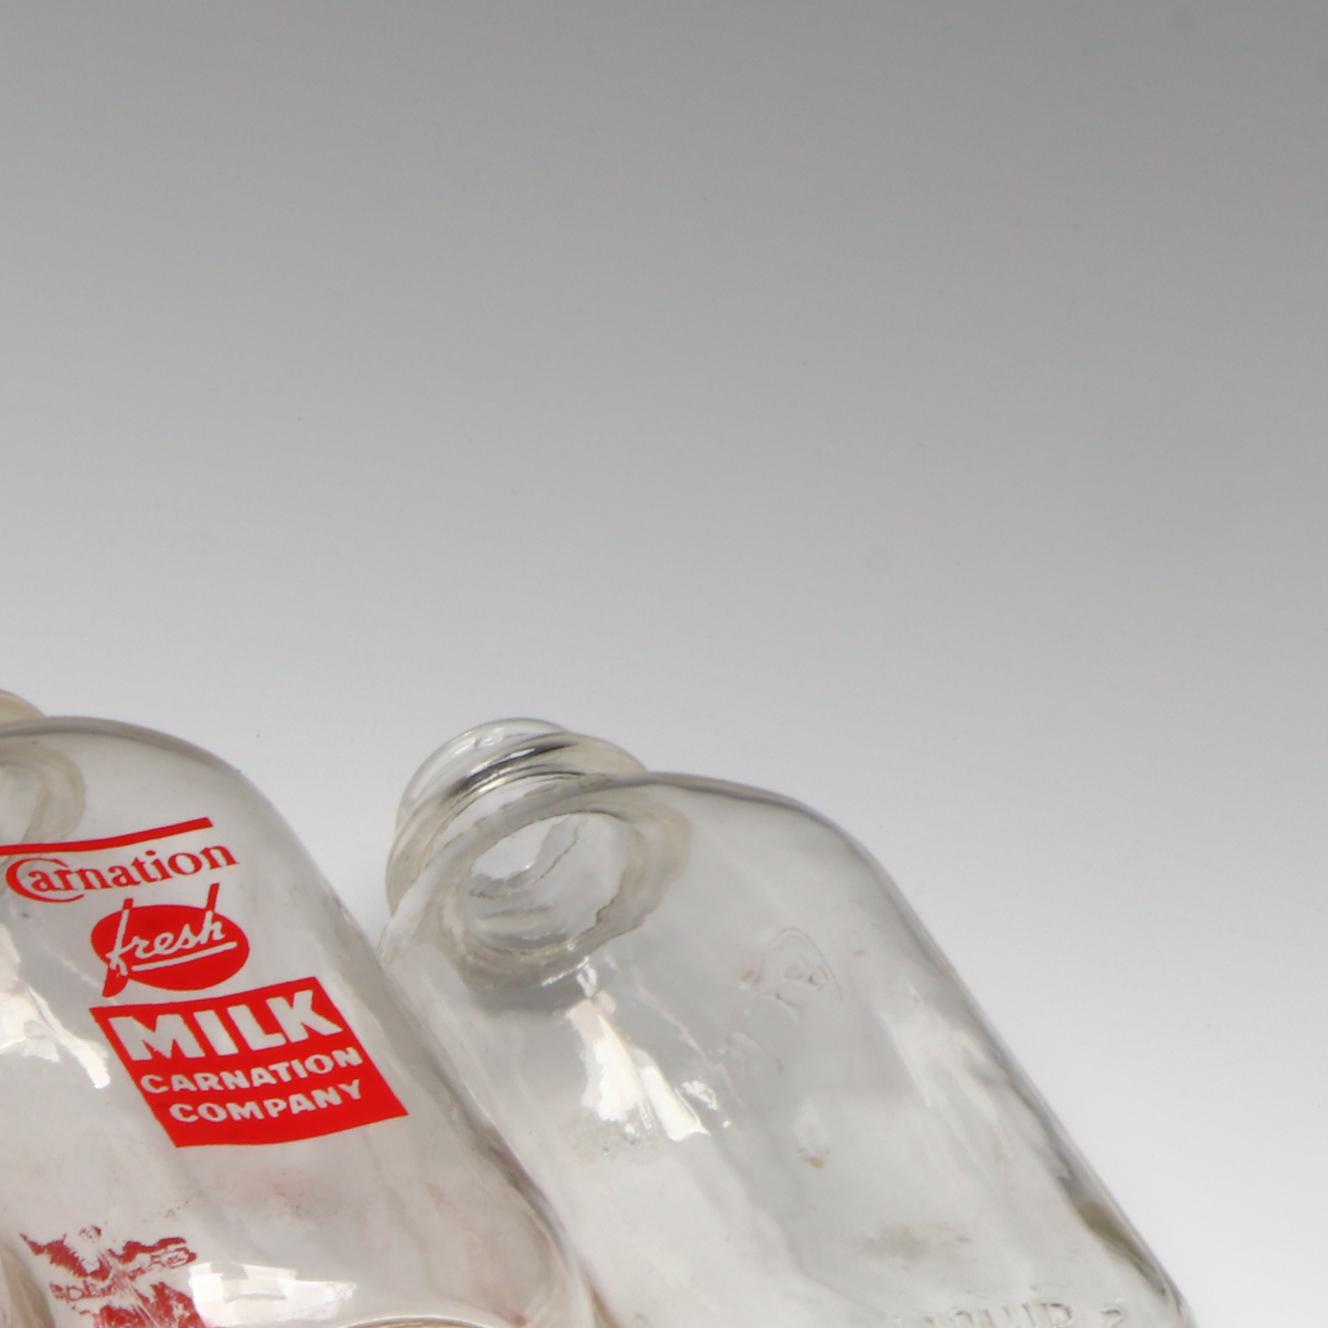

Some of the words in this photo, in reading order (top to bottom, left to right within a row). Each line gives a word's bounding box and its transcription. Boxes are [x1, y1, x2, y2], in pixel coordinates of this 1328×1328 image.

[5, 845, 239, 903] Carnation
[102, 882, 226, 998] fresh
[108, 989, 343, 1062] MILK
[141, 1047, 363, 1095] CARNATION
[169, 1079, 362, 1124] COMPANY
